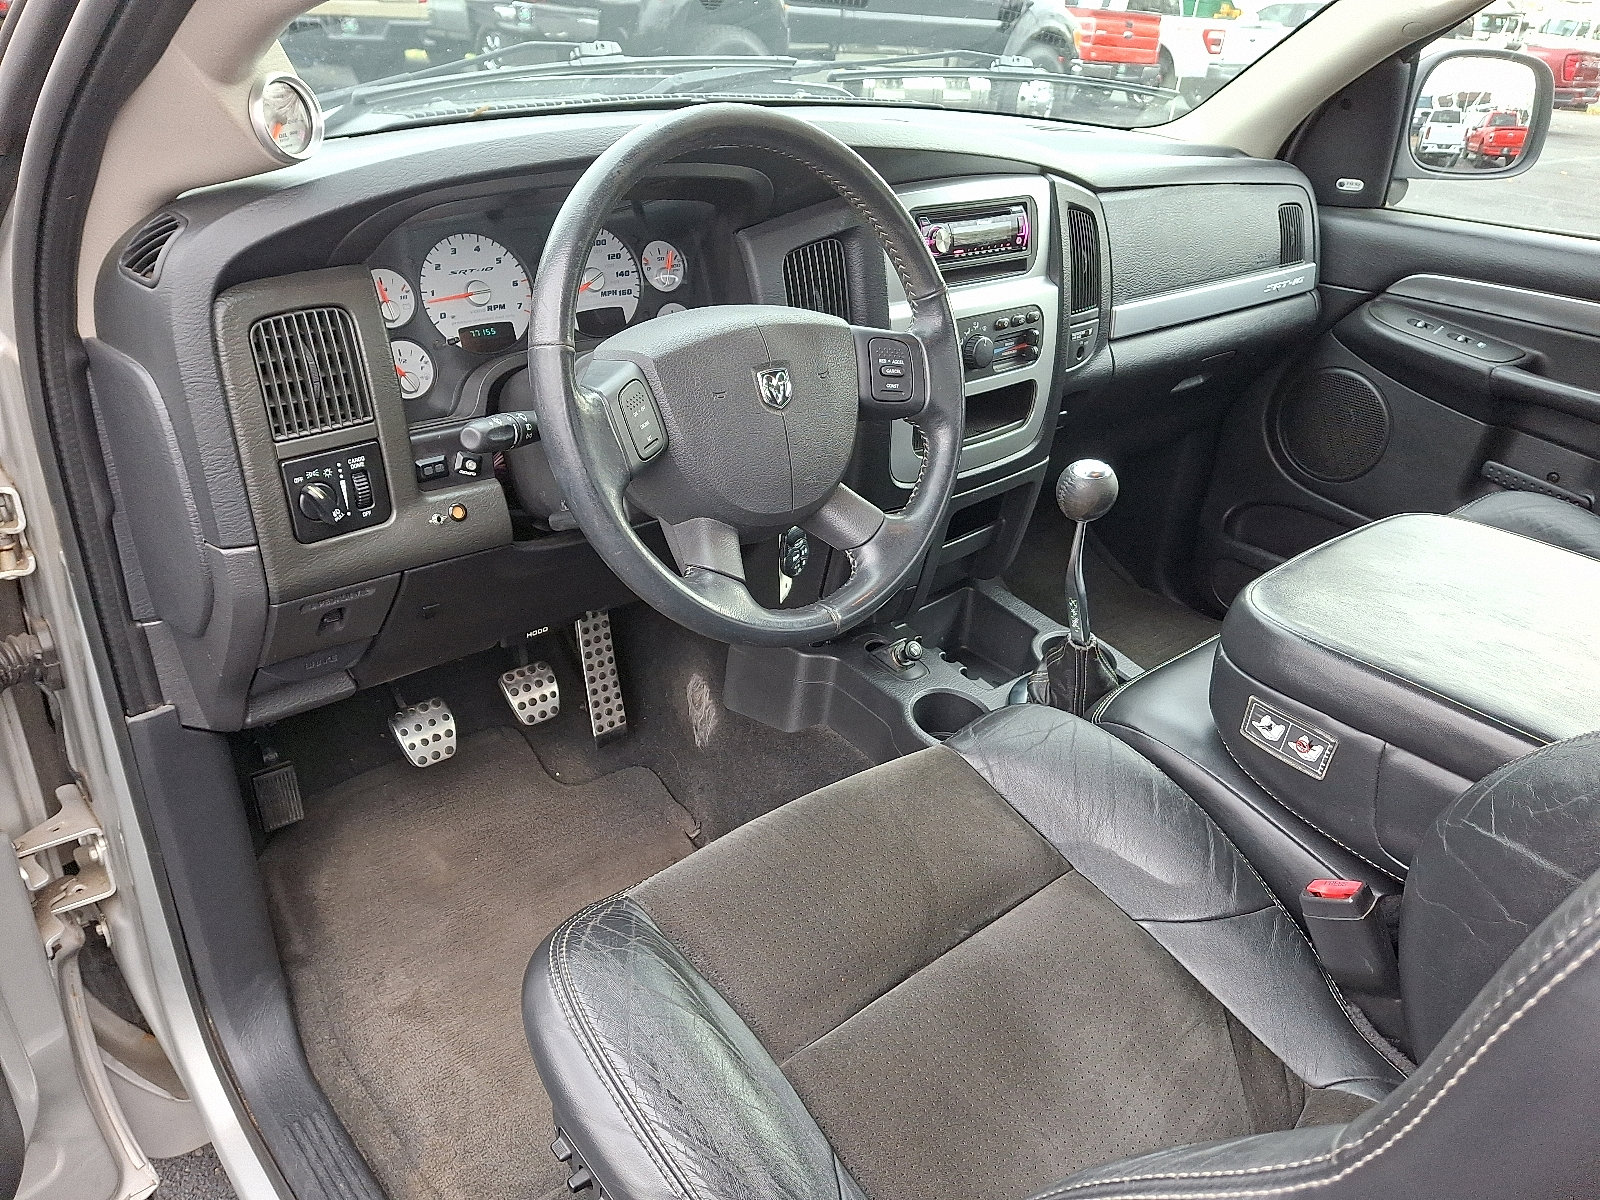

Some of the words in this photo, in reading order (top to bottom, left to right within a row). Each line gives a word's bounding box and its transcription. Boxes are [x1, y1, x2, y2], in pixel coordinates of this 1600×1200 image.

[450, 247, 457, 255] 3
[473, 245, 481, 253] 4
[495, 257, 502, 265] 5
[434, 263, 441, 271] 2
[448, 266, 495, 276] SRT-10
[615, 270, 630, 278] 140
[430, 289, 435, 297] 1
[600, 290, 618, 298] MPH
[618, 288, 633, 297] 160
[486, 303, 506, 312] RPM
[516, 302, 523, 310] 7
[439, 312, 447, 320] 0
[347, 455, 366, 465] CARGO
[350, 461, 365, 469] DOME
[293, 476, 304, 484] OFF
[362, 510, 373, 518] OFF
[526, 626, 549, 638] HOOD
